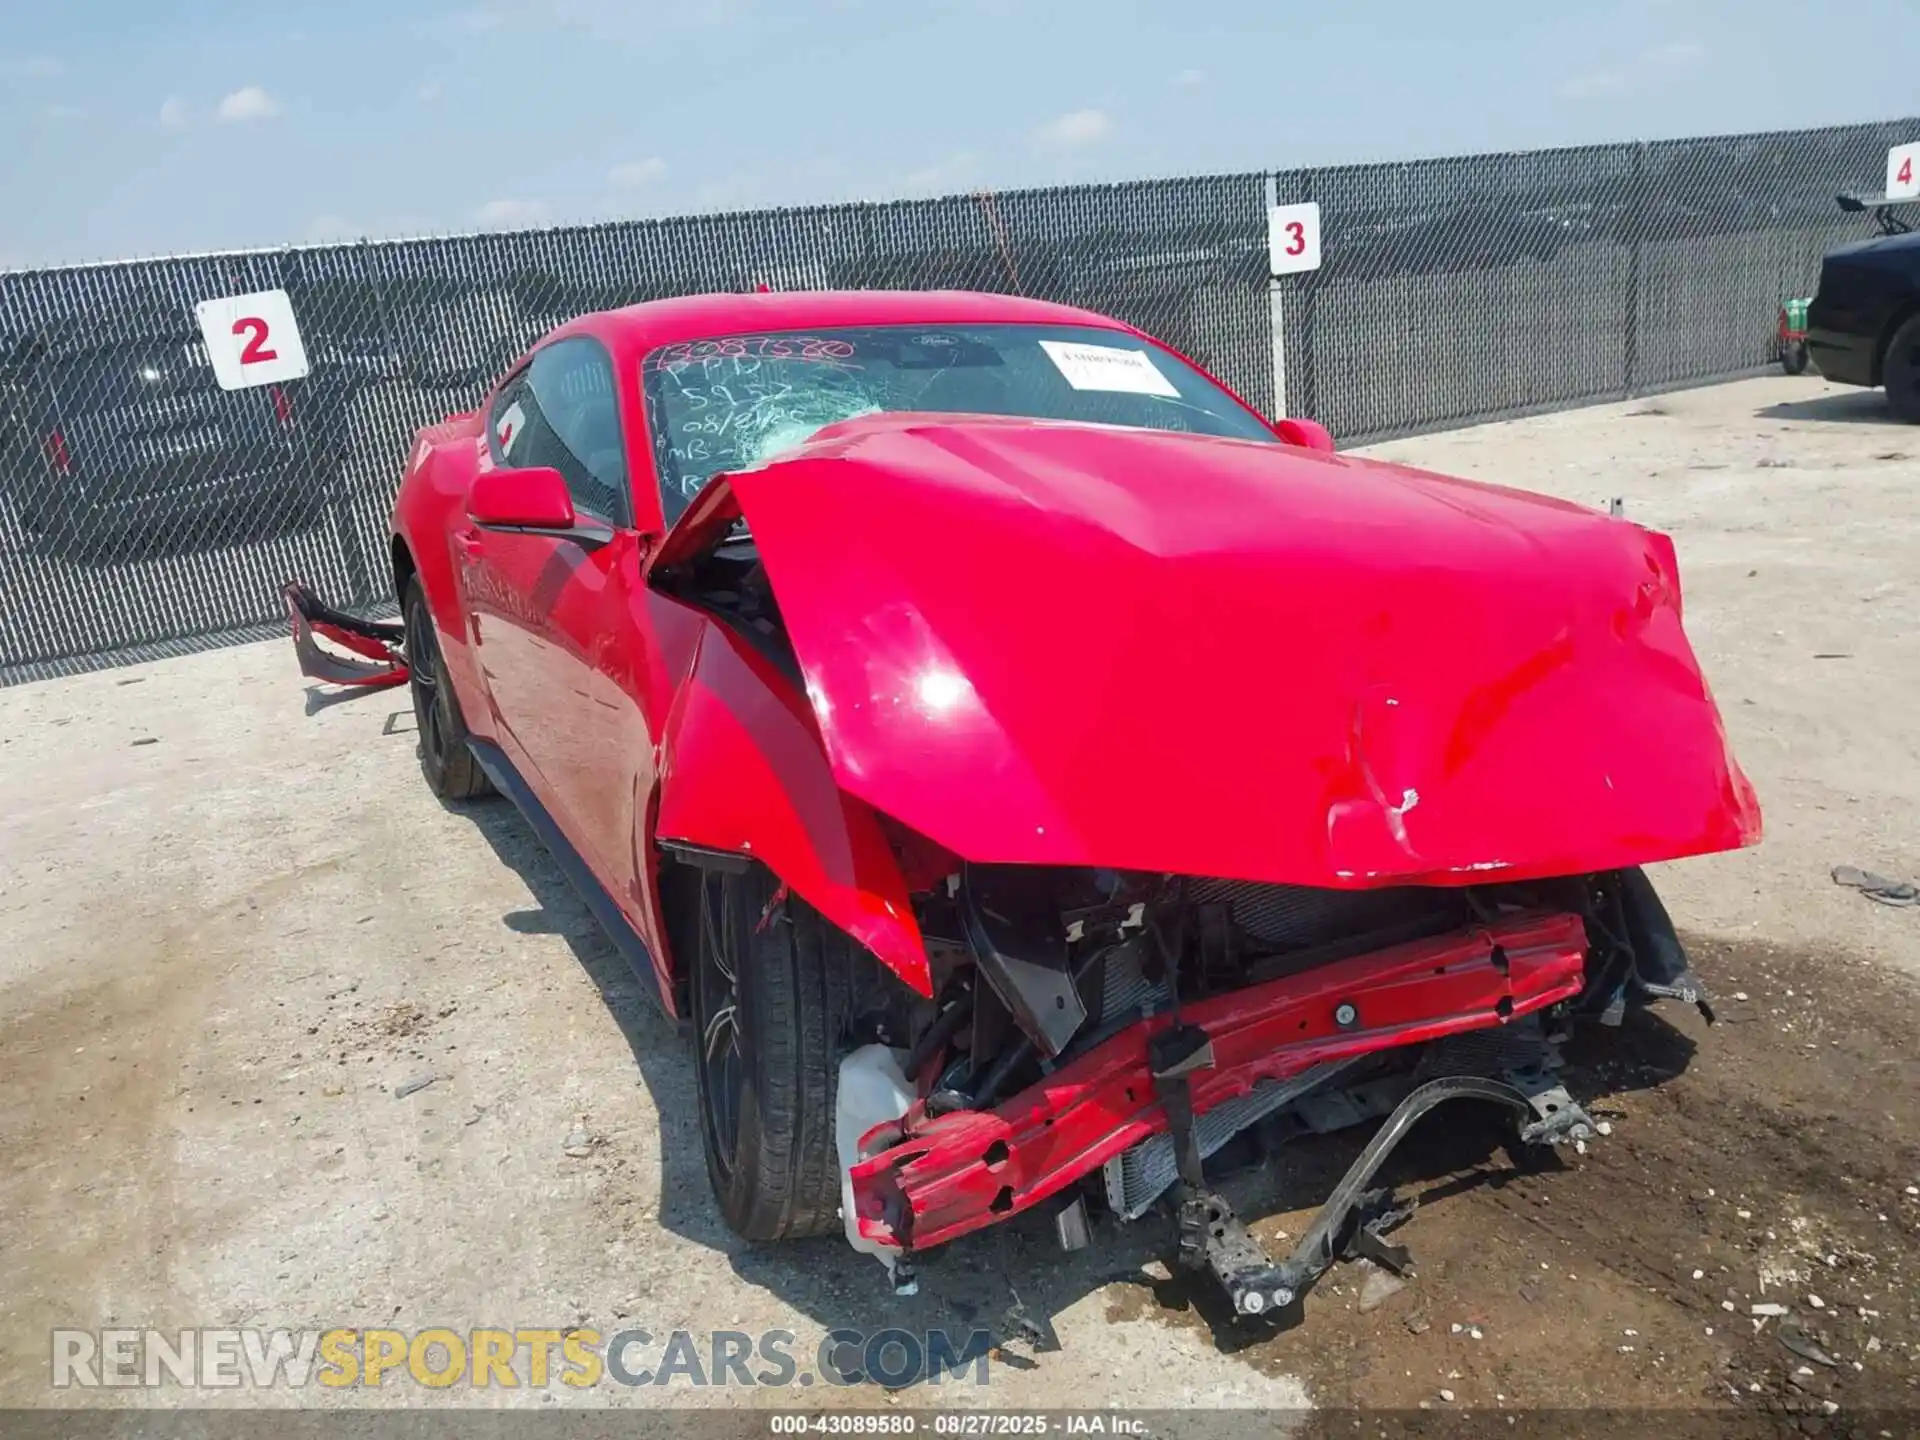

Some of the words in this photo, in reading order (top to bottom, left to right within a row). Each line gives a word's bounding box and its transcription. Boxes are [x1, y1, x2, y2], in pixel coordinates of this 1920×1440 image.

[1896, 156, 1912, 185] 4
[1284, 221, 1306, 256] 3
[231, 316, 278, 365] 2
